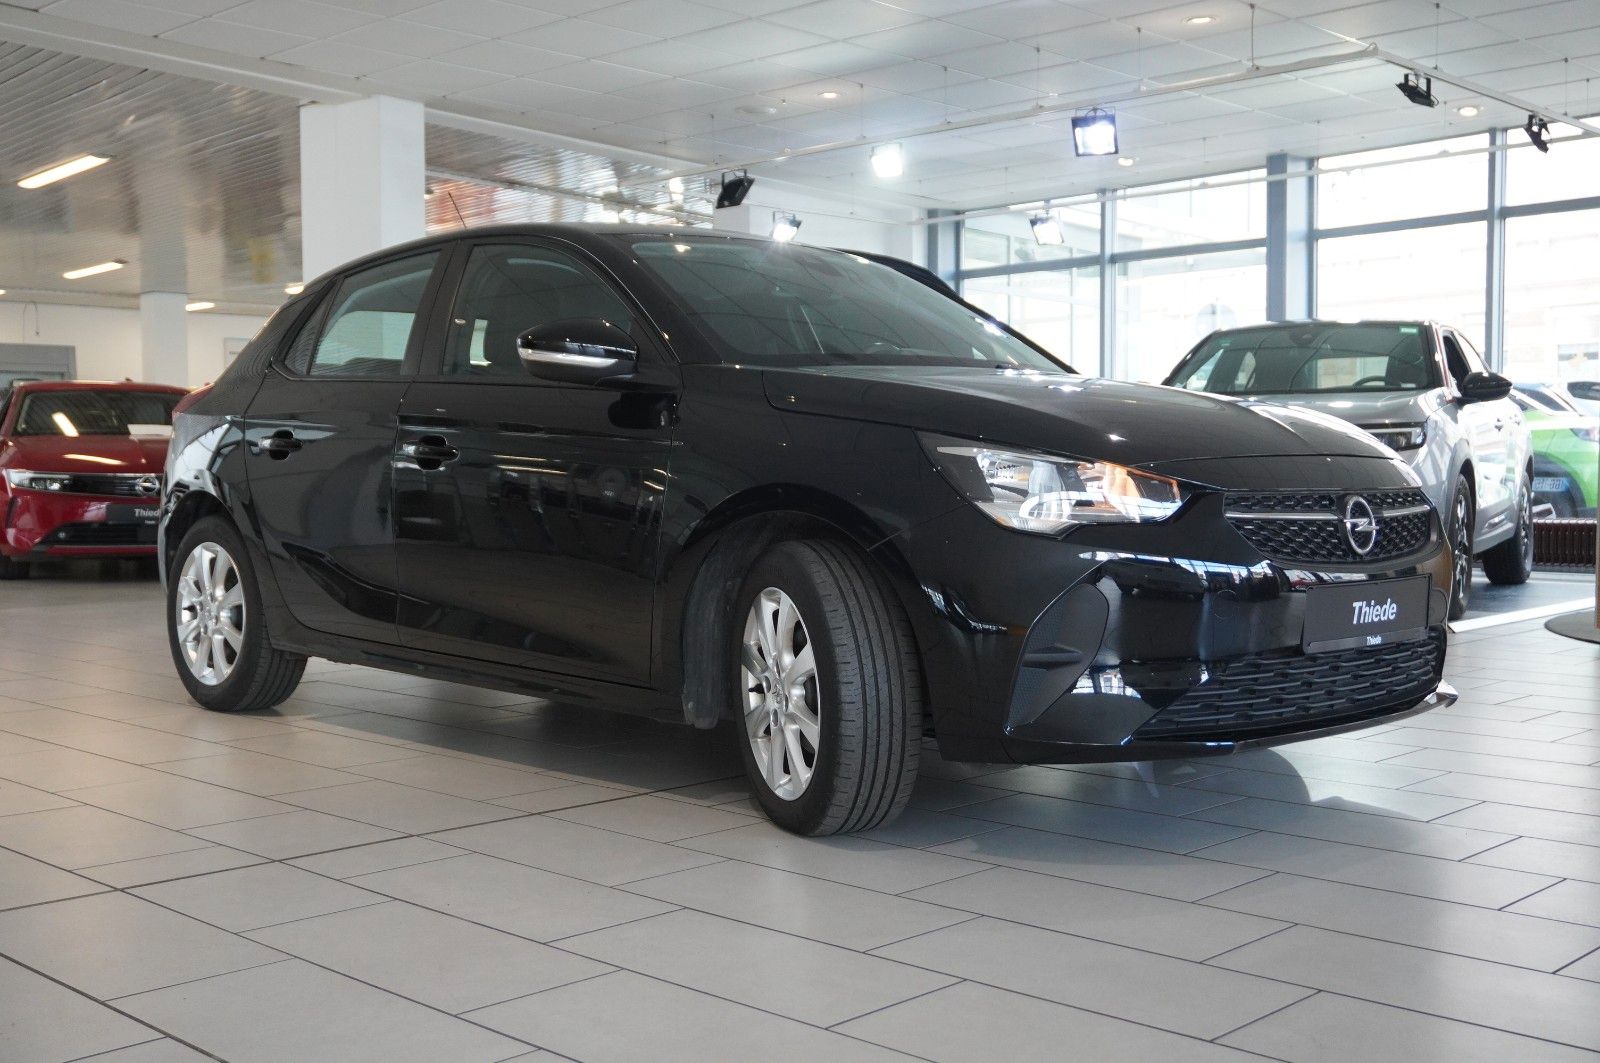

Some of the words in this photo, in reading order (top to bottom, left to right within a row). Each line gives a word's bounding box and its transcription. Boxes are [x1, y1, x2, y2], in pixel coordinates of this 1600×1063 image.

[134, 508, 161, 517] Thied
[1352, 598, 1397, 625] Thiede
[1366, 635, 1382, 646] Thiede
